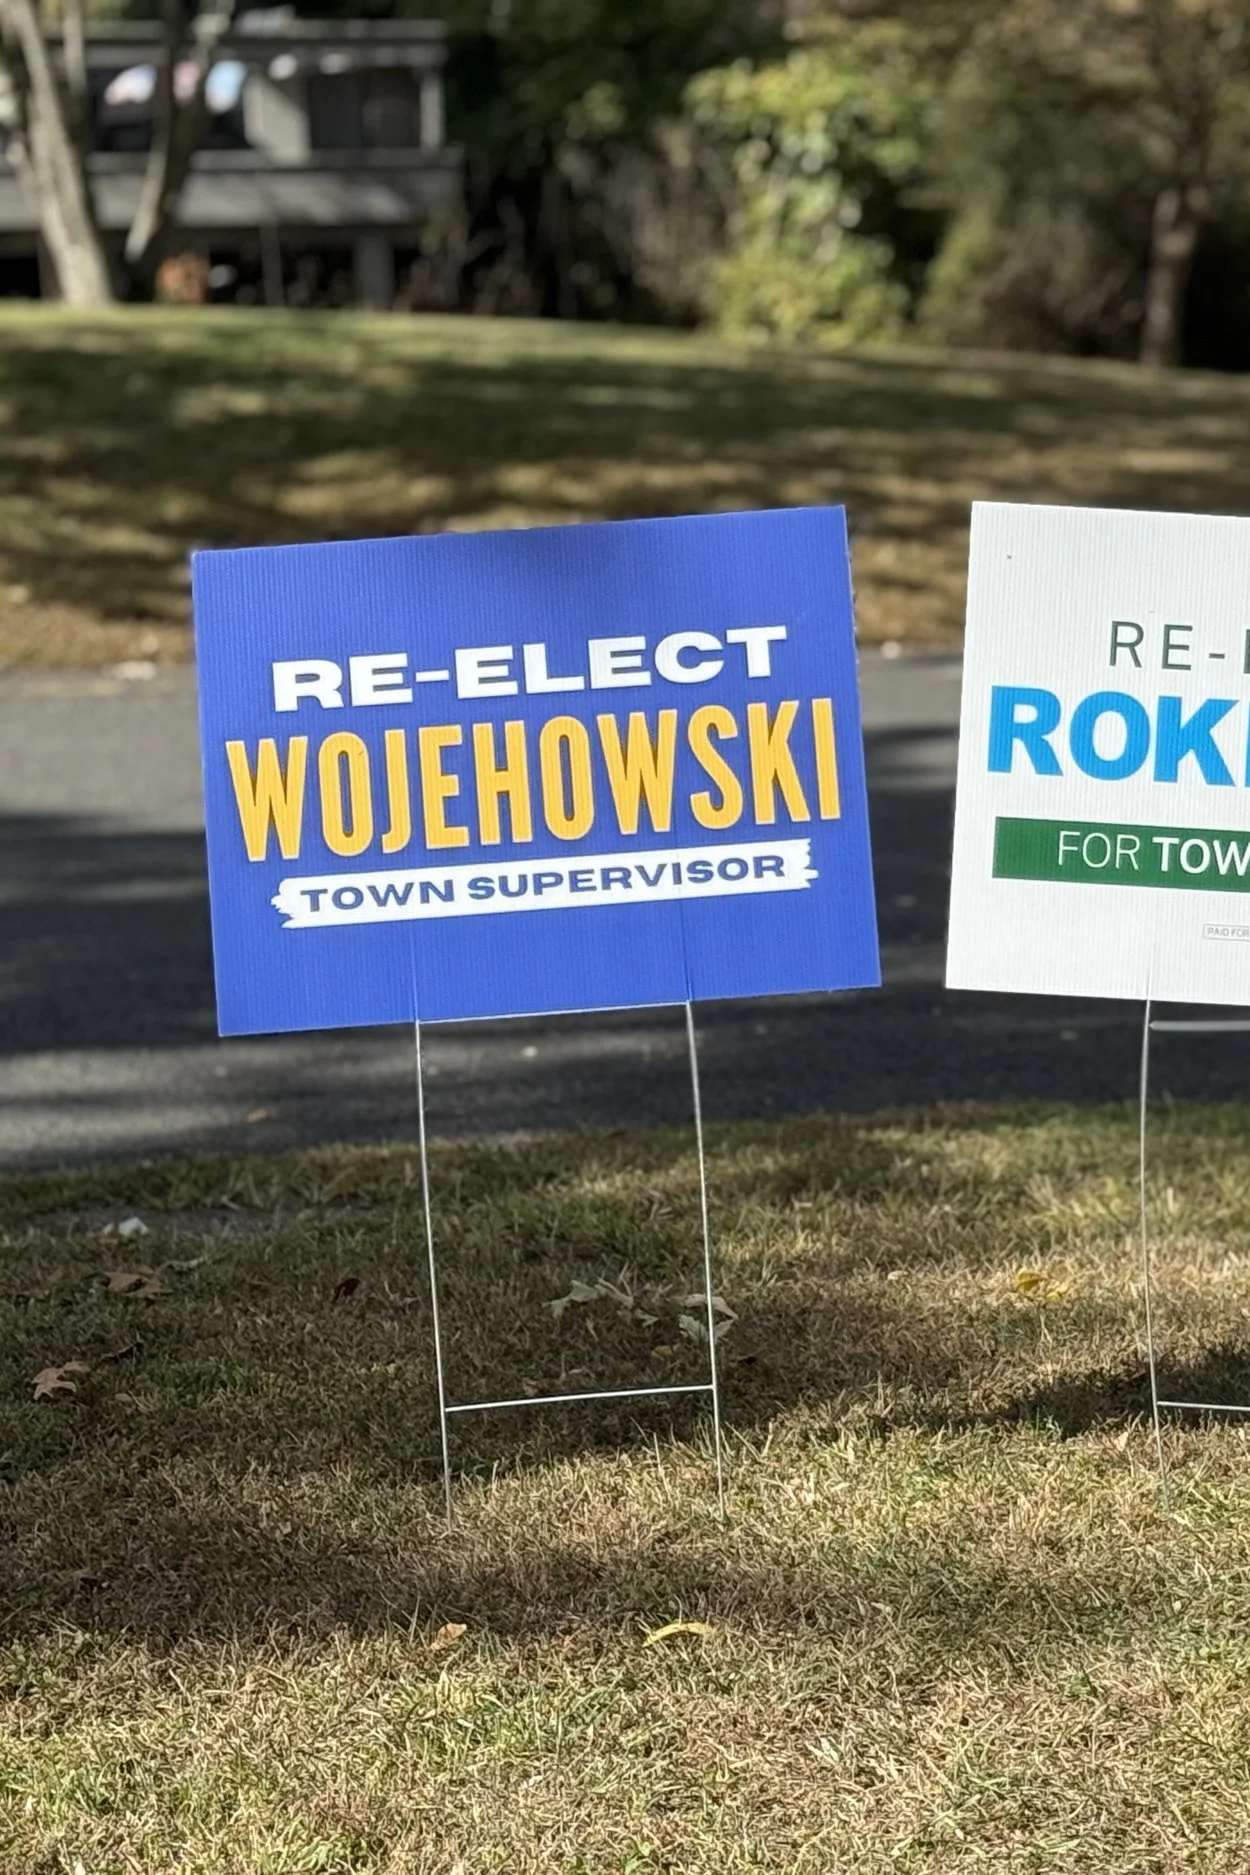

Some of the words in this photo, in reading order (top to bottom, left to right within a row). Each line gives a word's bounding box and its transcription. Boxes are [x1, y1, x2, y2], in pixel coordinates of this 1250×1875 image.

[272, 625, 788, 713] RE-ELECT
[225, 697, 841, 863] WOJEHOWSKI
[1057, 829, 1141, 871] FOR
[300, 878, 455, 914] TOWN
[467, 854, 786, 899] SUPERVISOR
[1206, 926, 1230, 937] PAID
[1231, 928, 1250, 939] FOR
